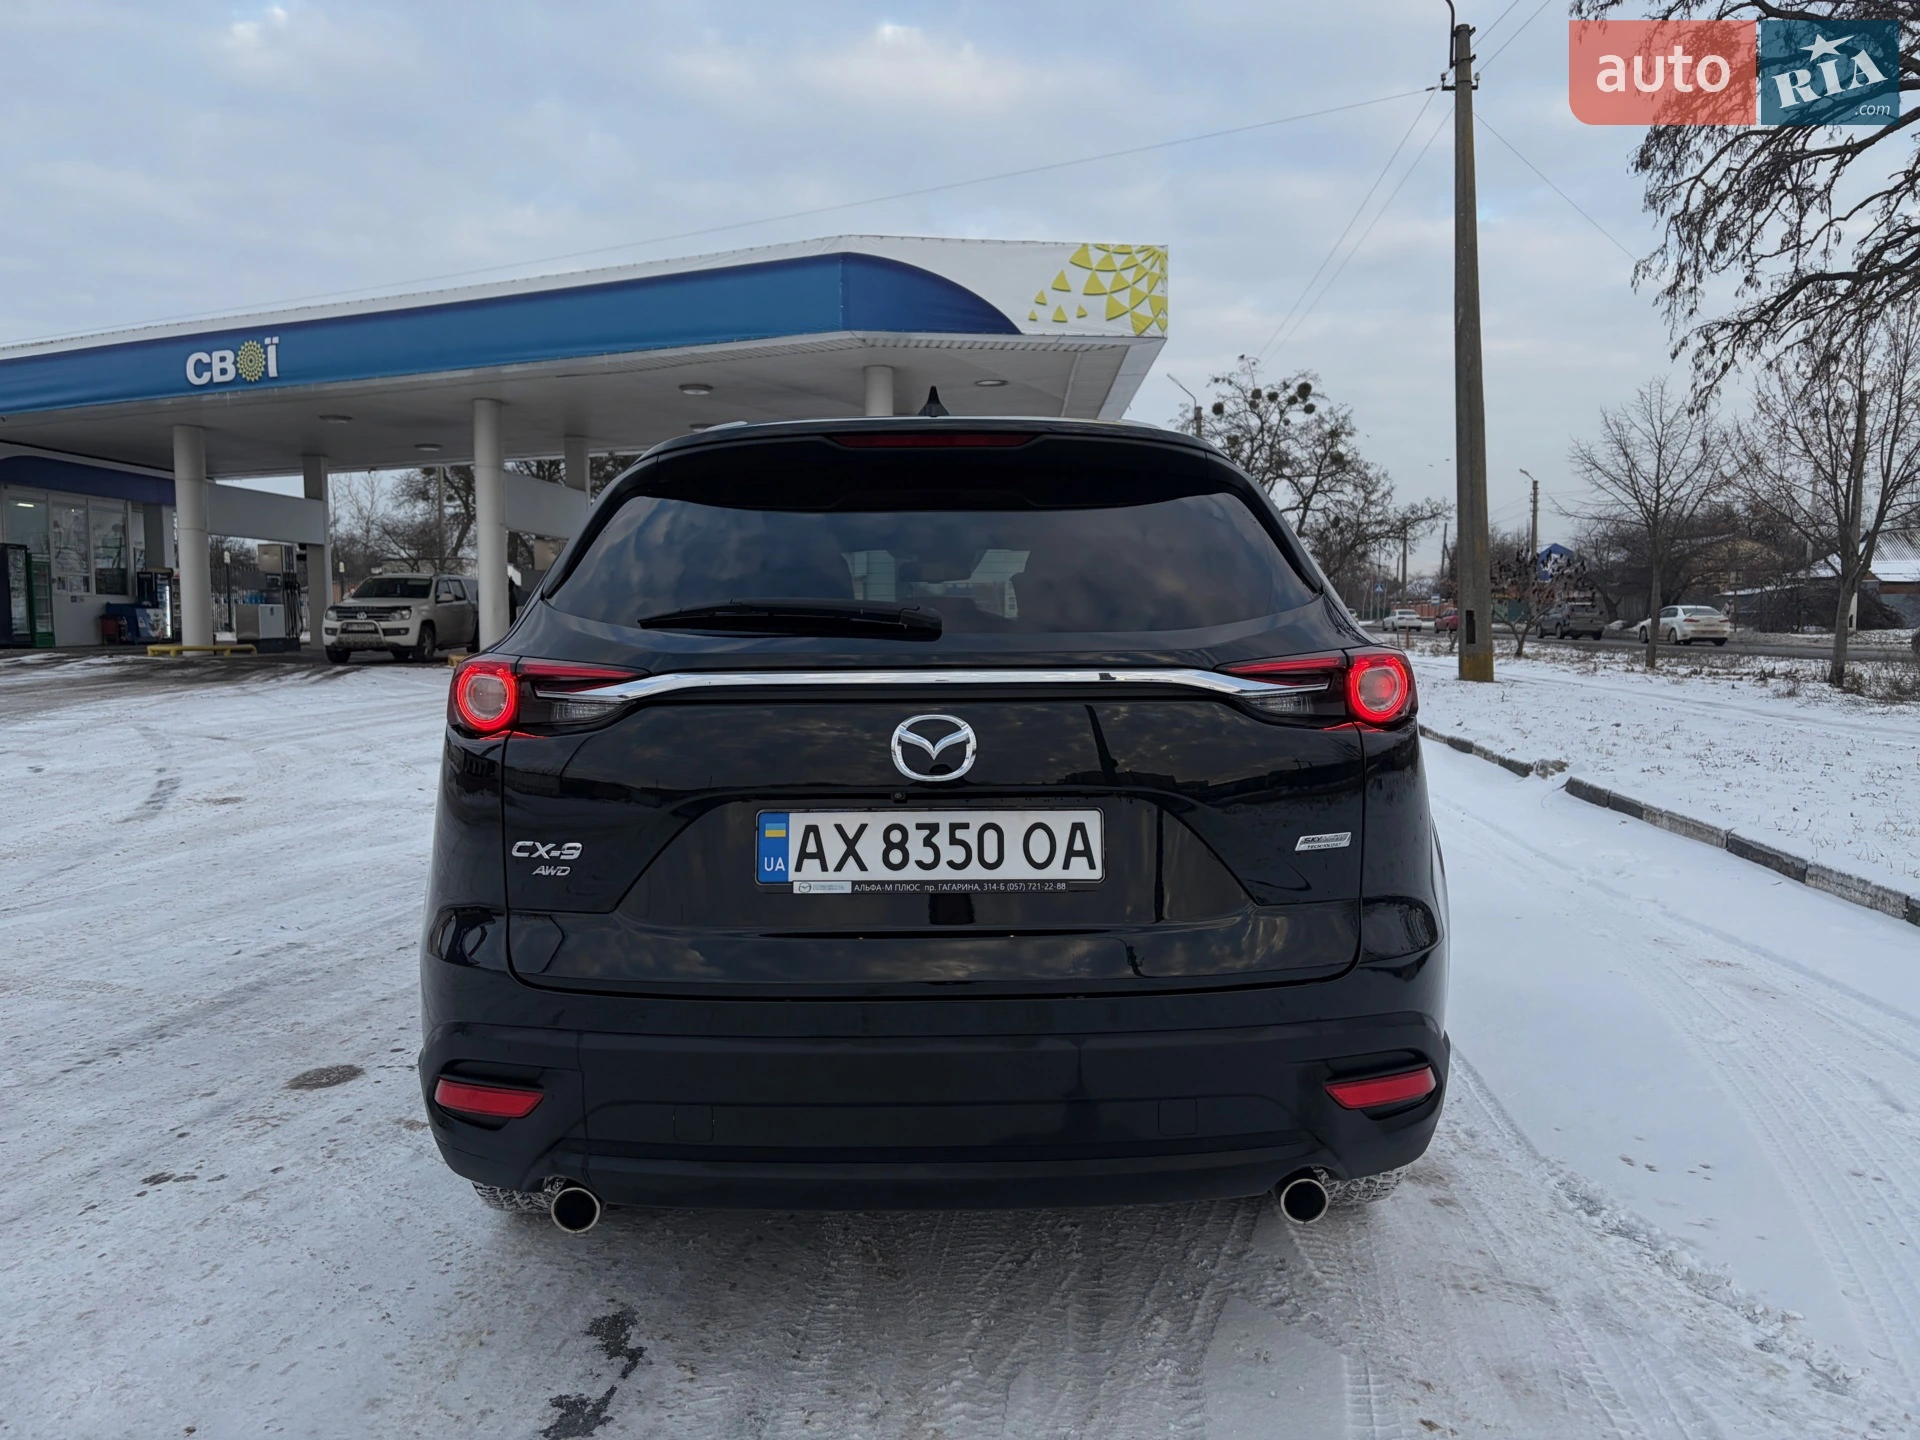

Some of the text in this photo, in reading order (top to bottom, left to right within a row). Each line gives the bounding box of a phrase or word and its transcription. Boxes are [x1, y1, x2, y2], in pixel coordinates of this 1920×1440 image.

[511, 840, 583, 860] CX-9
[794, 821, 1097, 873] AX 8350 OA
[532, 865, 571, 876] AWD
[764, 857, 786, 872] UA
[853, 883, 893, 892] АЛЬФА-М
[894, 883, 921, 891] ПЛЮС
[1007, 882, 1026, 892] (057)
[1027, 882, 1067, 891] 721-22-88
